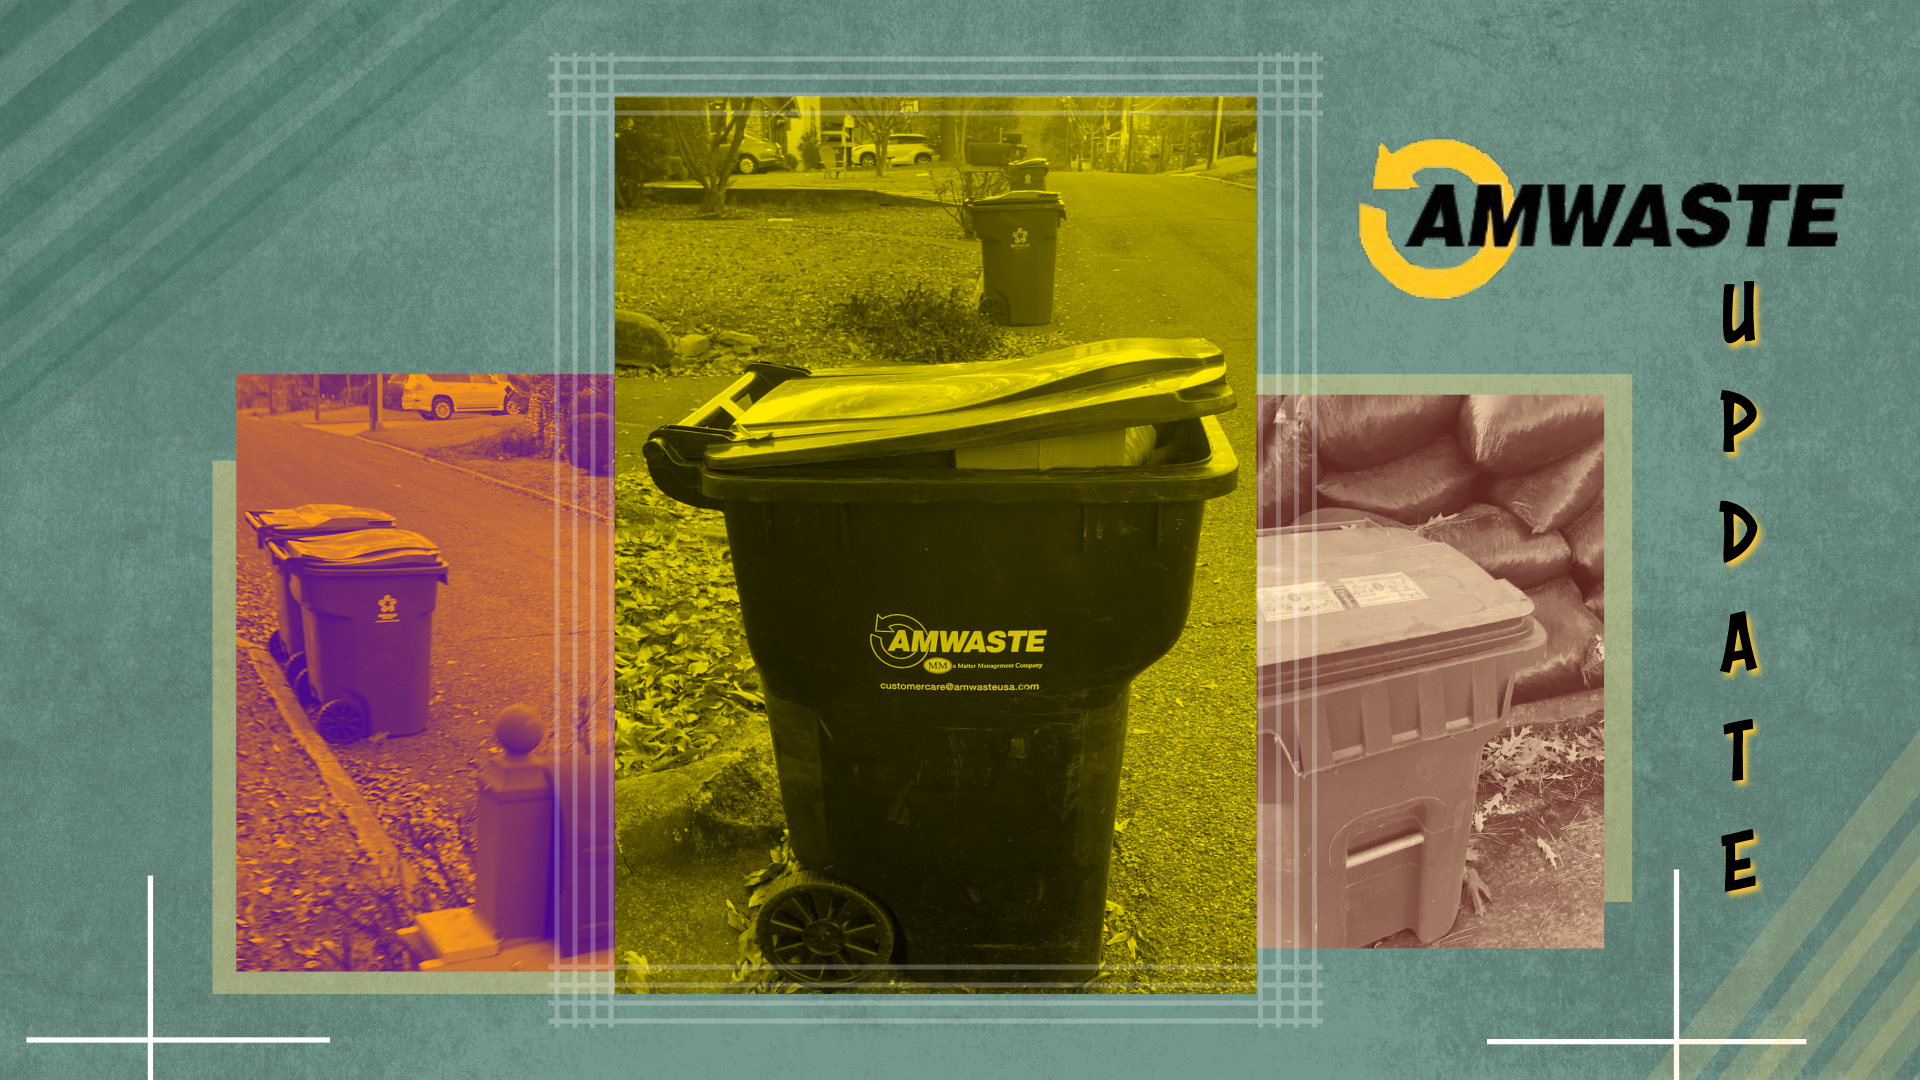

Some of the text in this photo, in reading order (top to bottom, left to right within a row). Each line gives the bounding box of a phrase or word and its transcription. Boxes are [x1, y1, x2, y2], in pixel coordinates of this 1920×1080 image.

[887, 629, 1048, 653] AMWASTE
[928, 661, 948, 670] MM
[1014, 662, 1043, 670] Company
[880, 682, 1040, 691] customercare@amwasteusa.com
